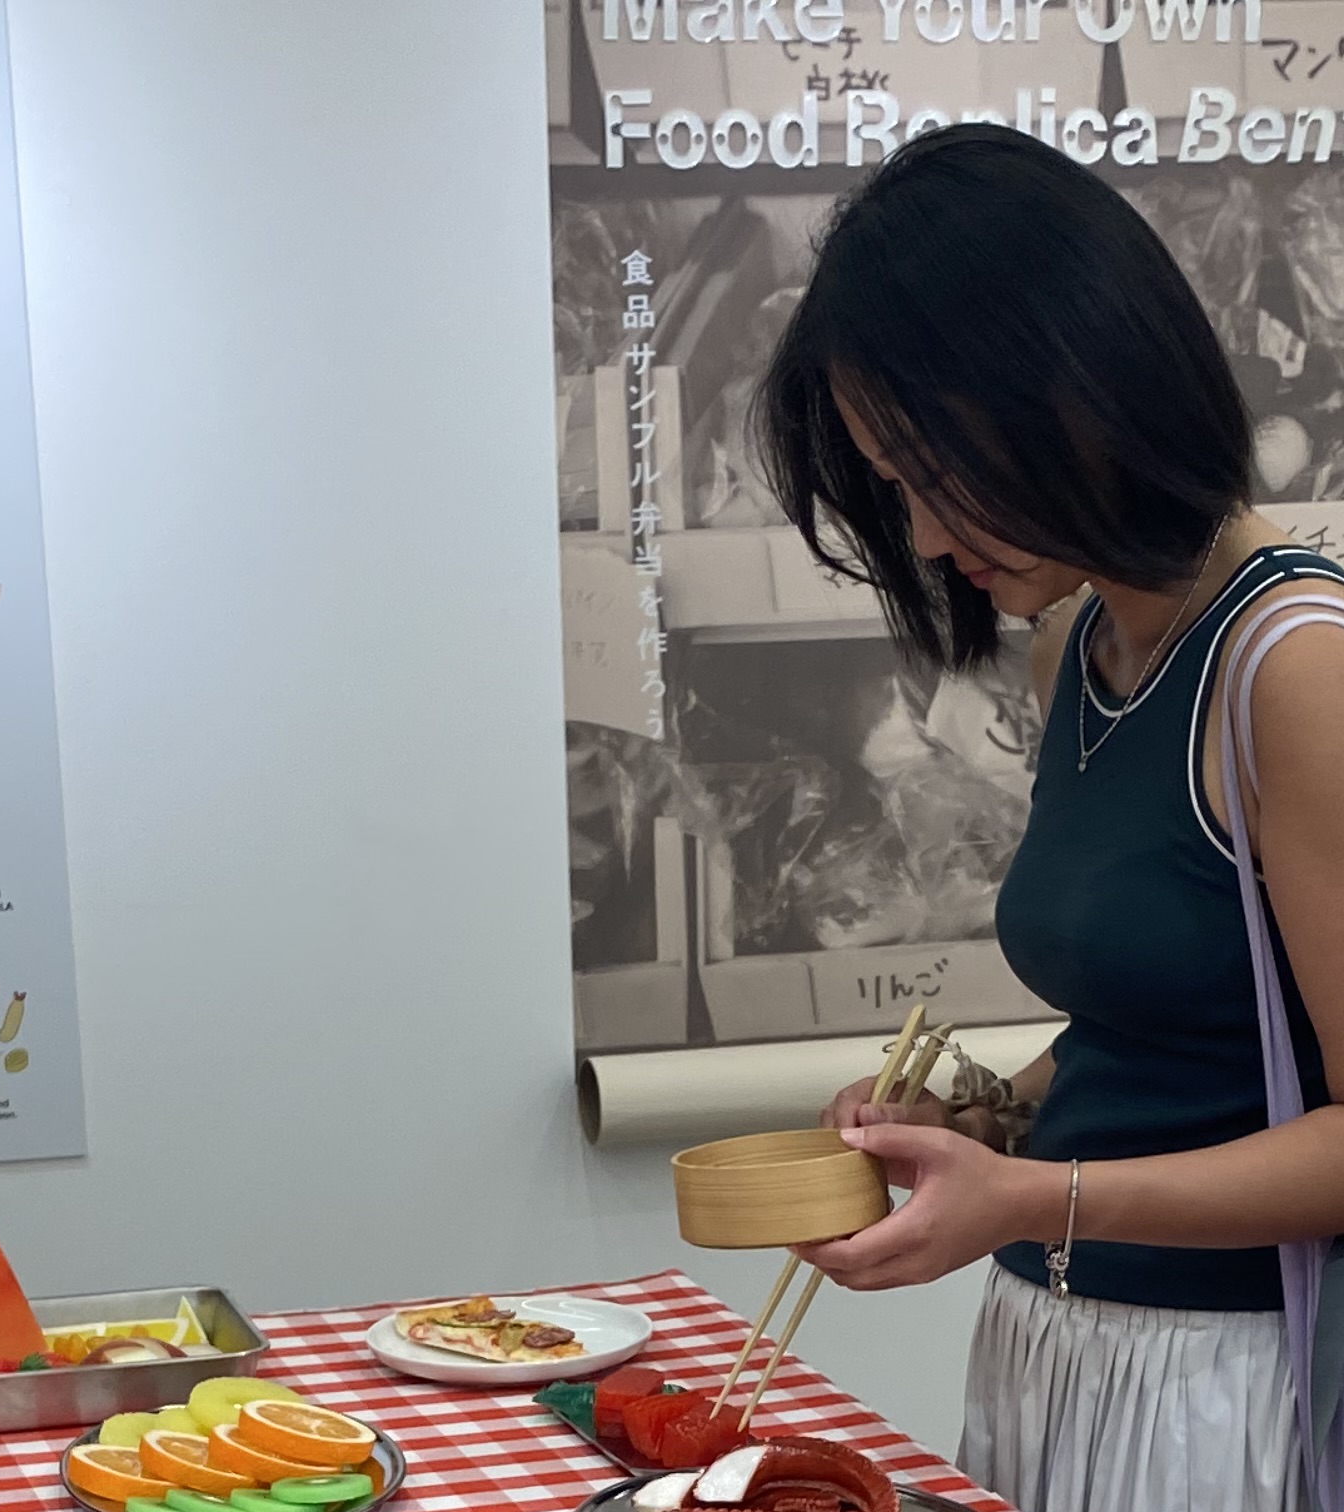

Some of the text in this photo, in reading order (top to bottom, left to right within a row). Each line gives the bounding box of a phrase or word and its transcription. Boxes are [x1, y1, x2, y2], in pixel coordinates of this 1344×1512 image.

[606, 88, 819, 169] Food
[846, 87, 1158, 166] Rlica
[620, 248, 667, 739] 食品サンプル弁当を作ろう
[858, 958, 948, 1008] りんご
